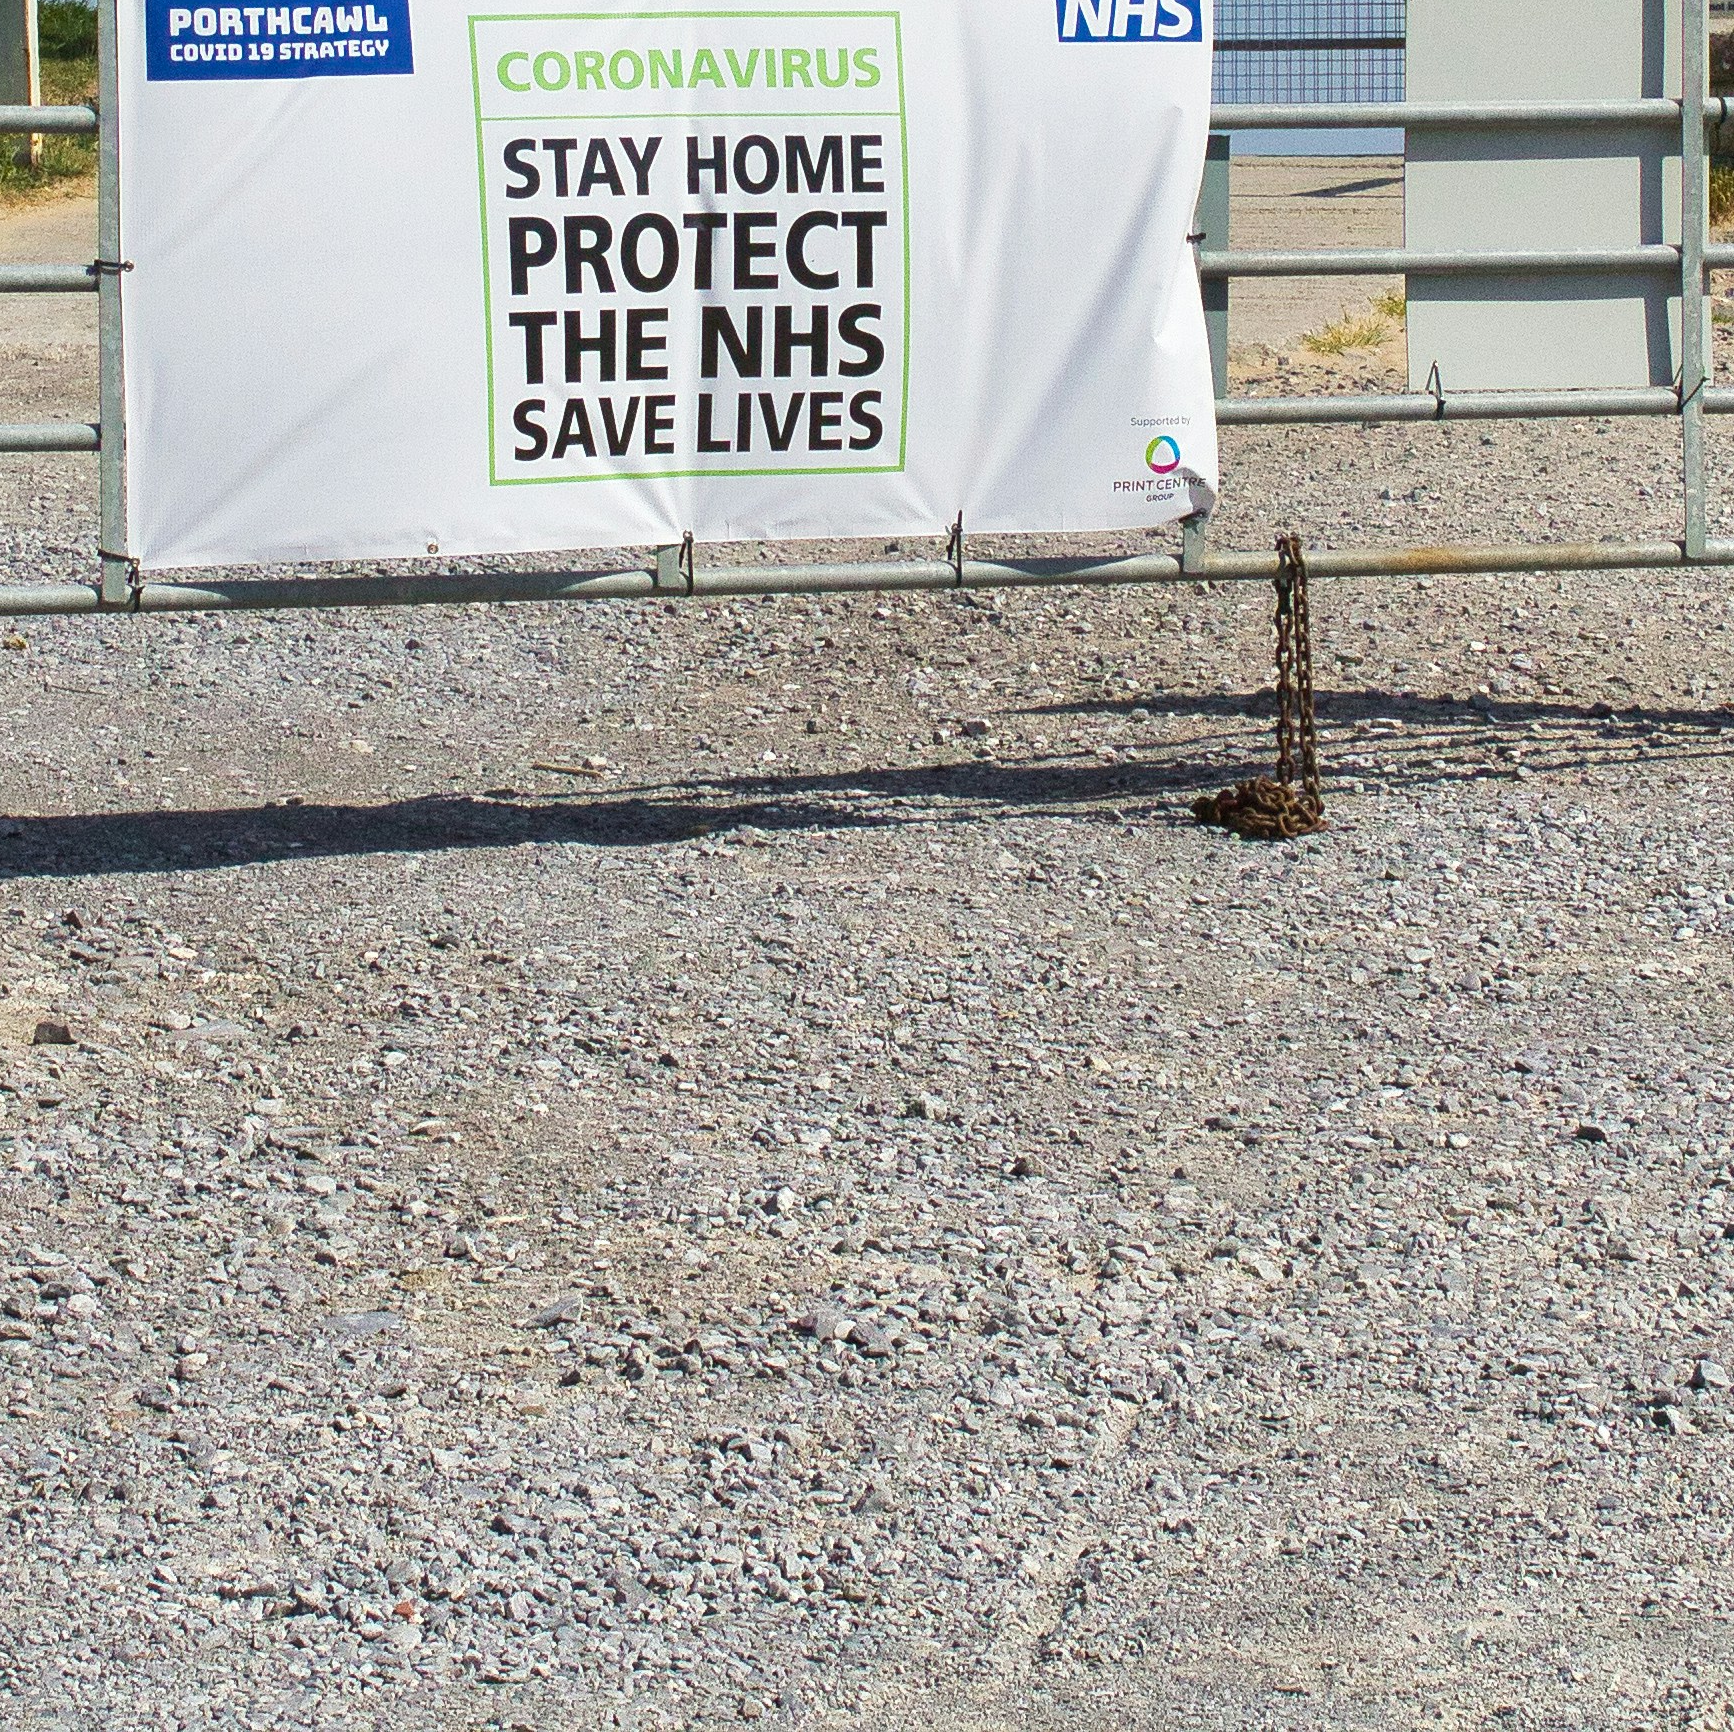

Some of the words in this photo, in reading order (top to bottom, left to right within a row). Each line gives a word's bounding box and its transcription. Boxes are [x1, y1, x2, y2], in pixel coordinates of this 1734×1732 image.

[169, 5, 388, 37] PORTHCAWL
[170, 43, 243, 62] COVID
[248, 41, 274, 61] 19
[279, 39, 390, 61] STRATEGY
[496, 47, 881, 92] CORONAVIRUS
[503, 136, 663, 199] STAY
[685, 134, 885, 196] HOME
[508, 210, 888, 296] PROTECT
[508, 307, 669, 385] THE
[700, 303, 885, 380] NHS
[512, 394, 677, 463] SAVE
[696, 389, 884, 454] LIVES
[1131, 416, 1179, 427] Supported
[1182, 416, 1191, 425] by
[1113, 480, 1154, 493] PRINT
[1156, 476, 1206, 491] CENTRE
[1146, 493, 1174, 502] GROUP
